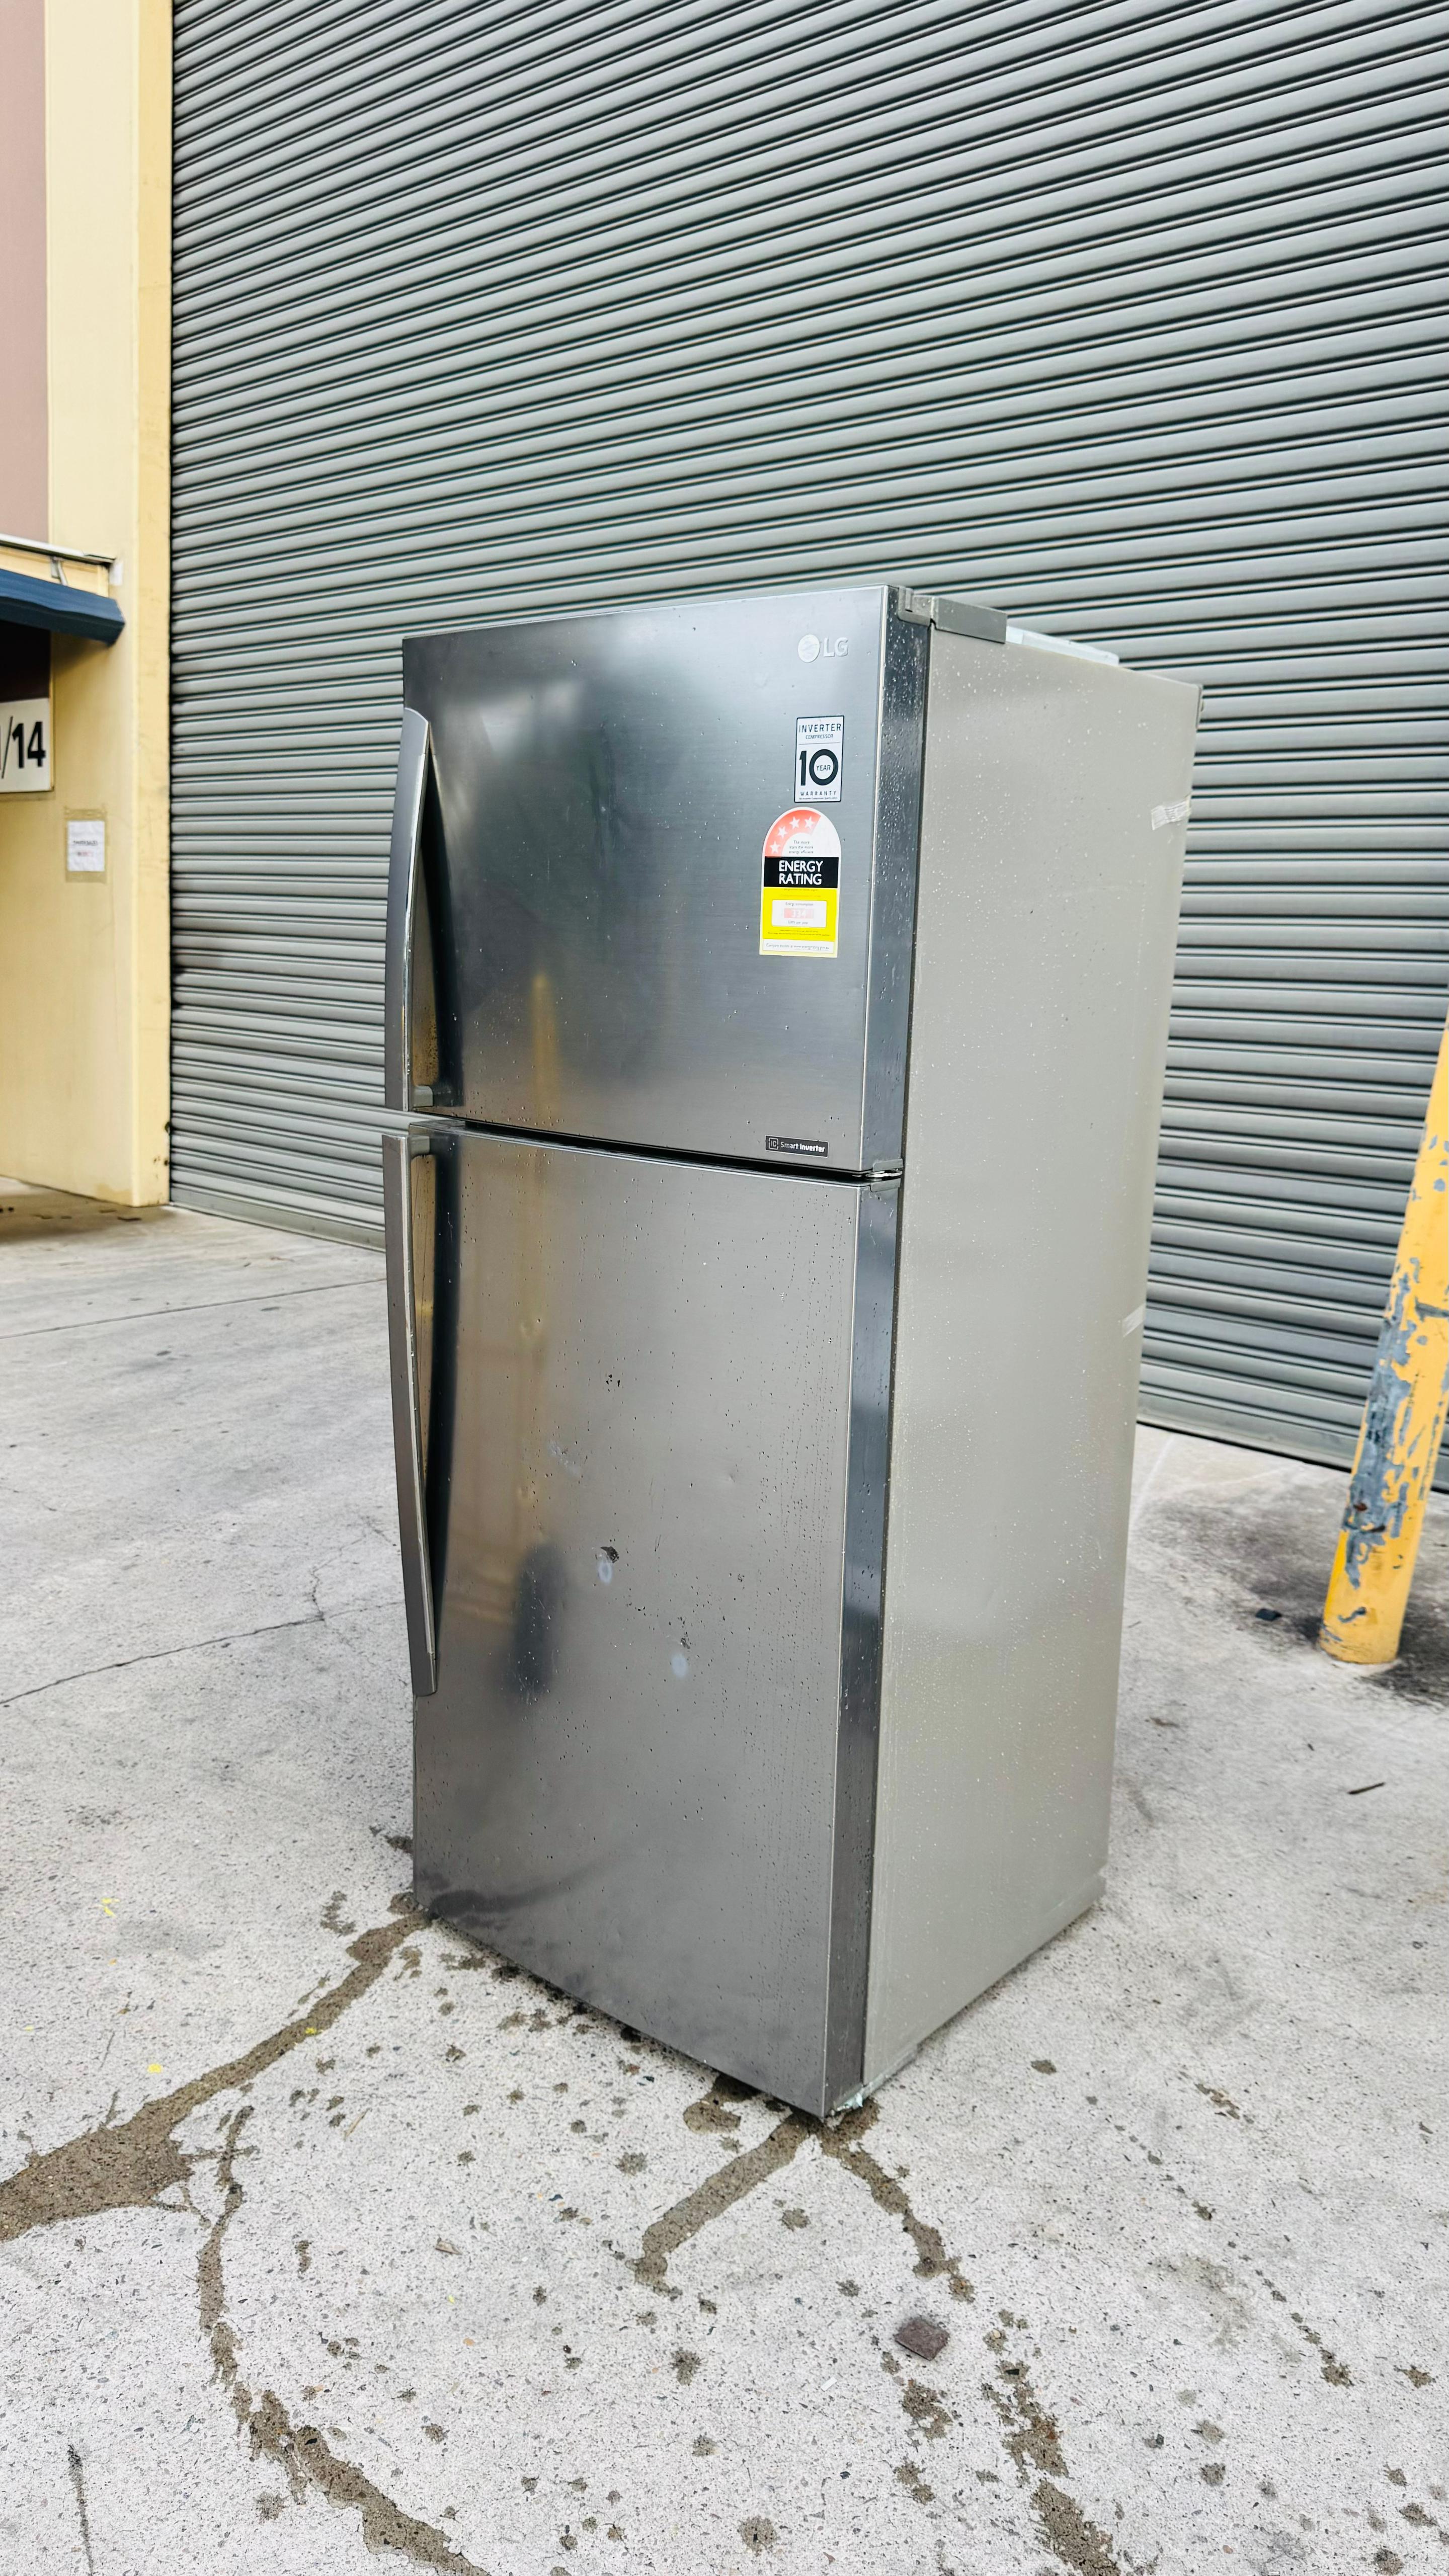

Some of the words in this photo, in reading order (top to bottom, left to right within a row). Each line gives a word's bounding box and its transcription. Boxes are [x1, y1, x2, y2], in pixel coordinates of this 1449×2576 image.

[823, 637, 848, 657] LG
[798, 723, 841, 733] INVERTER
[0, 716, 46, 779] /14
[799, 749, 839, 786] 10
[779, 860, 824, 872] ENERGY
[779, 873, 822, 885] RATING
[780, 1141, 798, 1149] Smart
[799, 1143, 825, 1152] Inverter
